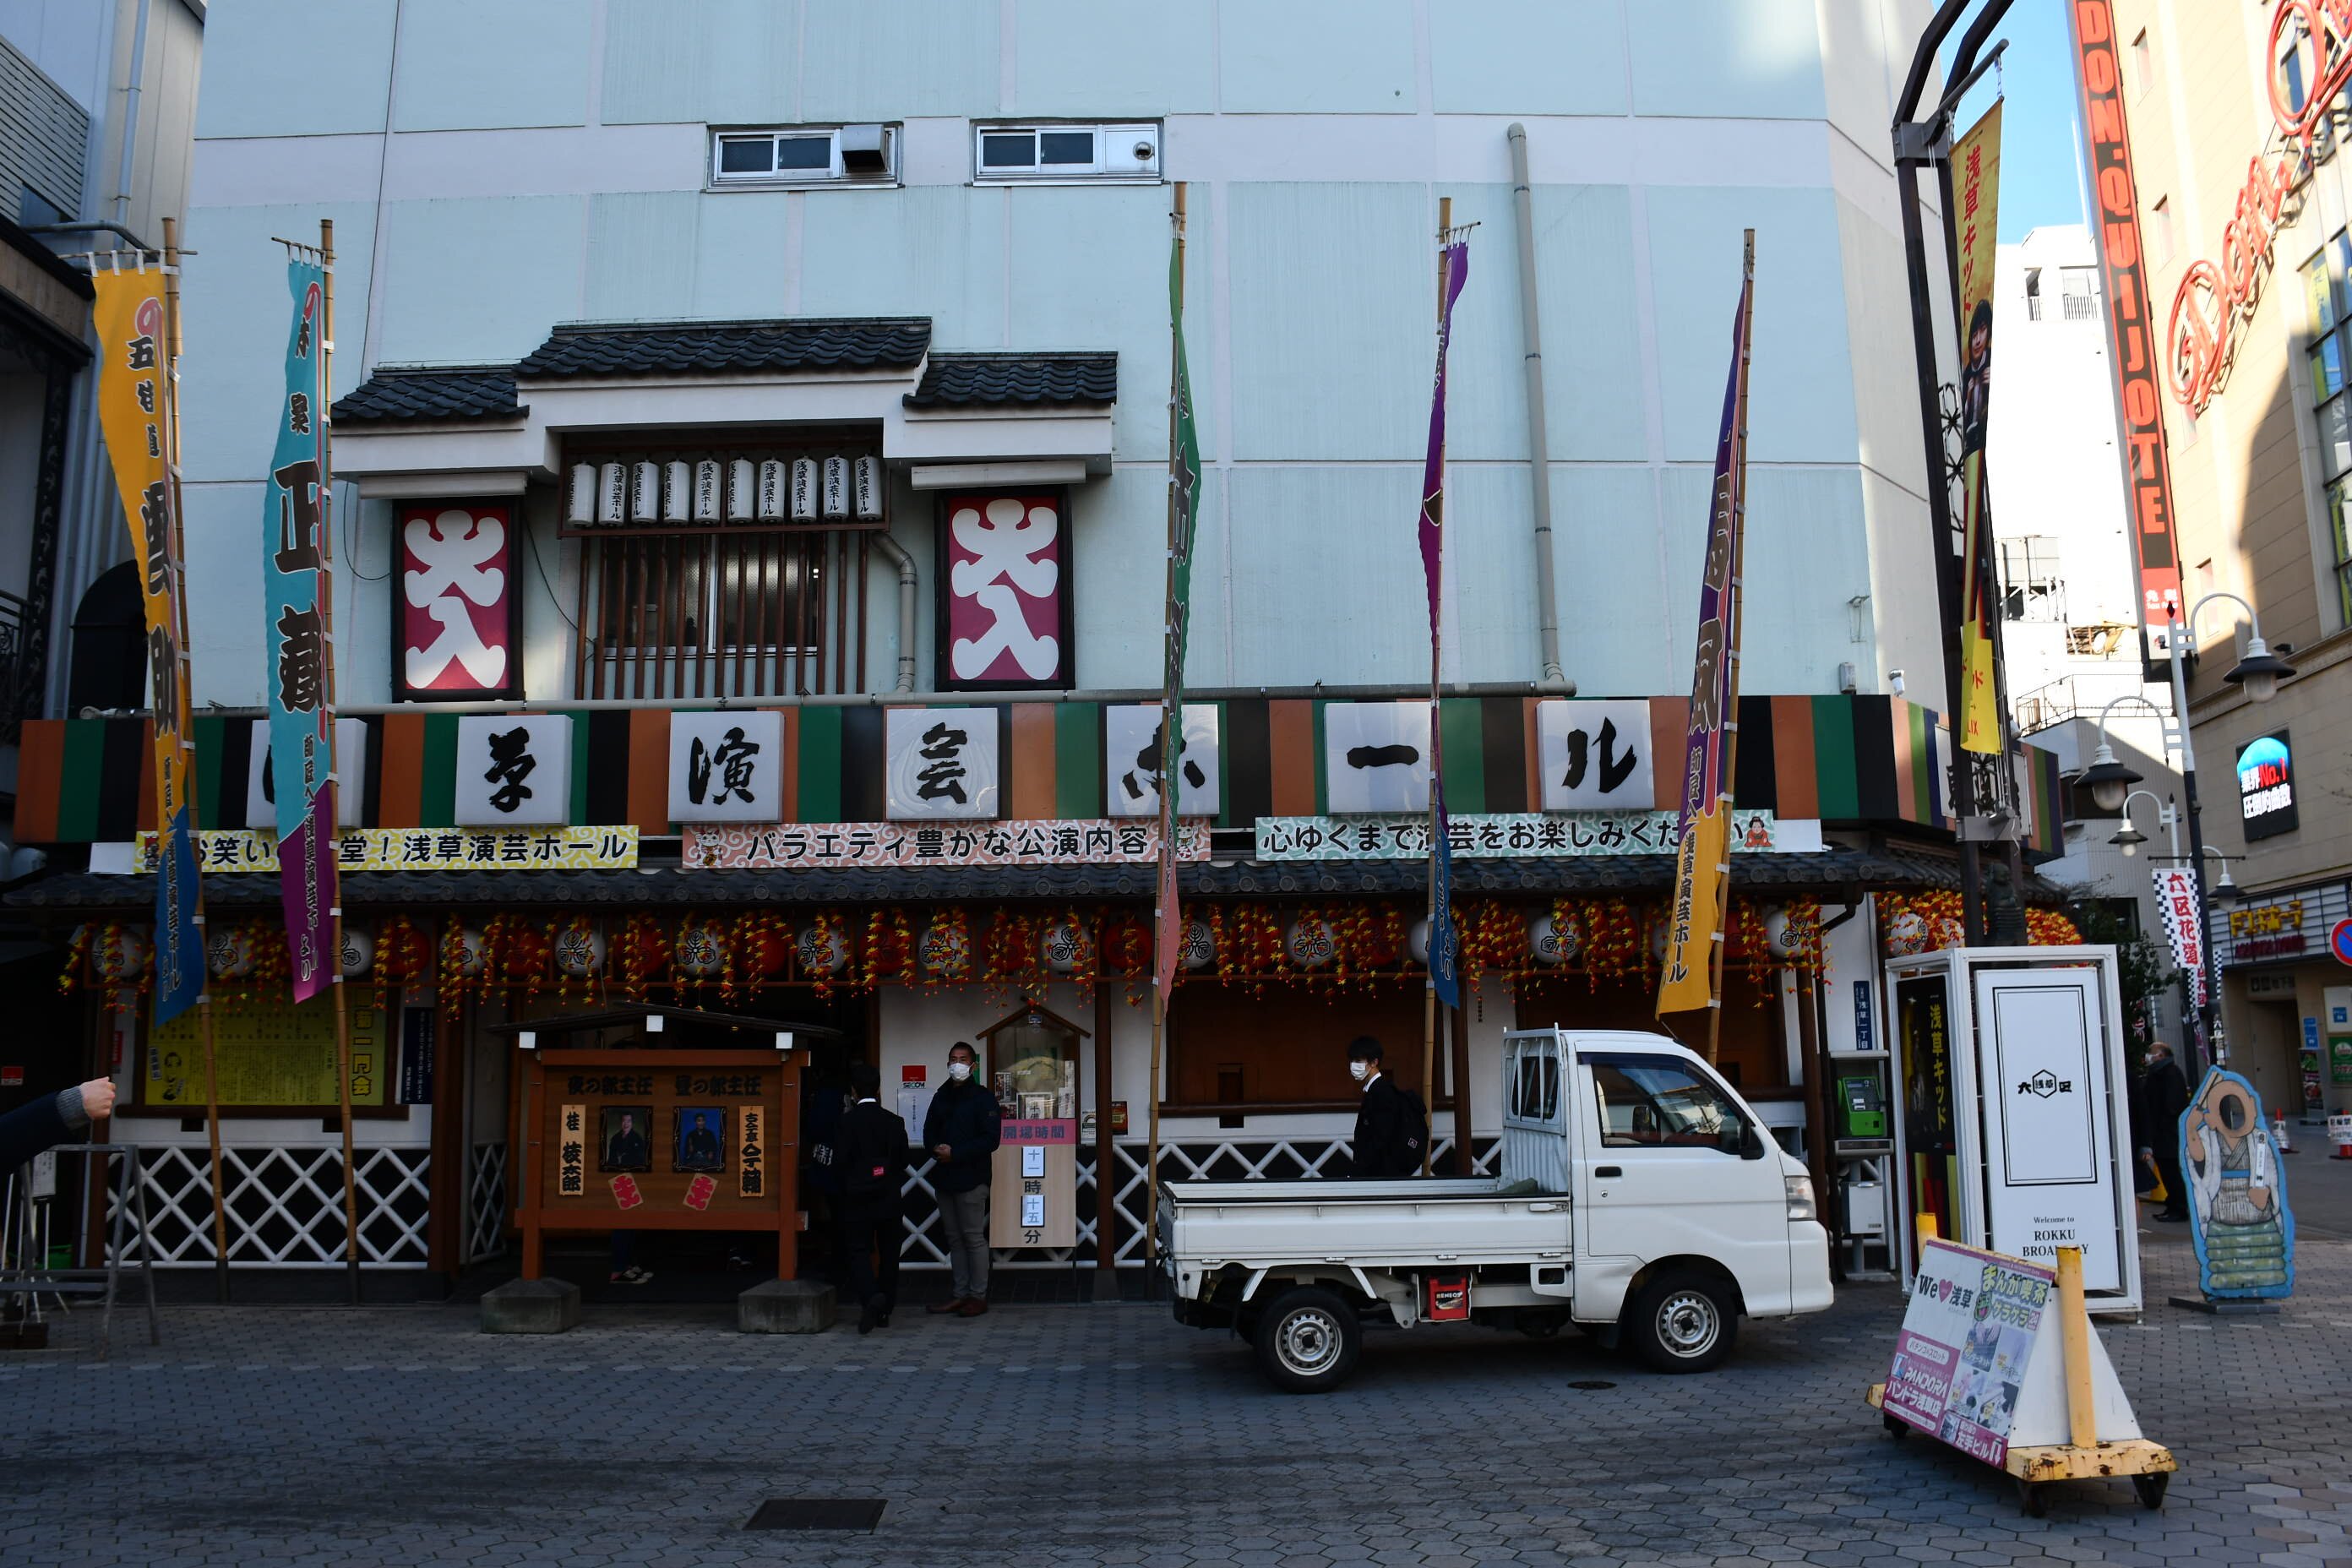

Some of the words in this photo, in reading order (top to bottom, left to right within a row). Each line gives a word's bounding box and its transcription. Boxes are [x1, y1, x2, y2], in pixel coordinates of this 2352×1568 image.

[1963, 144, 1981, 326] 浅草キッド
[611, 466, 623, 520] 浅草演芸ホール
[701, 462, 713, 517] 浅草演芸ホール
[764, 463, 776, 515] 浅草演芸ホール
[796, 460, 808, 514] 浅草演芸ホール
[829, 459, 841, 511] 浅草演芸ホール
[858, 459, 870, 513] 浅草演芸ホール
[404, 509, 505, 688] 大入
[952, 499, 1058, 679] 大入
[748, 825, 1148, 861] バラエティ豊かな公演内容
[1264, 819, 1743, 853] 心ゆくまで芸をお楽しみくだ
[2167, 873, 2198, 965] 六区花道
[1930, 1004, 1947, 1131] 浅草キッド
[1003, 1125, 1064, 1139] 開場時間
[2023, 1244, 2088, 1256] BROAY
[2034, 1229, 2075, 1241] ROKKU
[1917, 1274, 1939, 1298] We
[1949, 1285, 1974, 1309] 浅草
